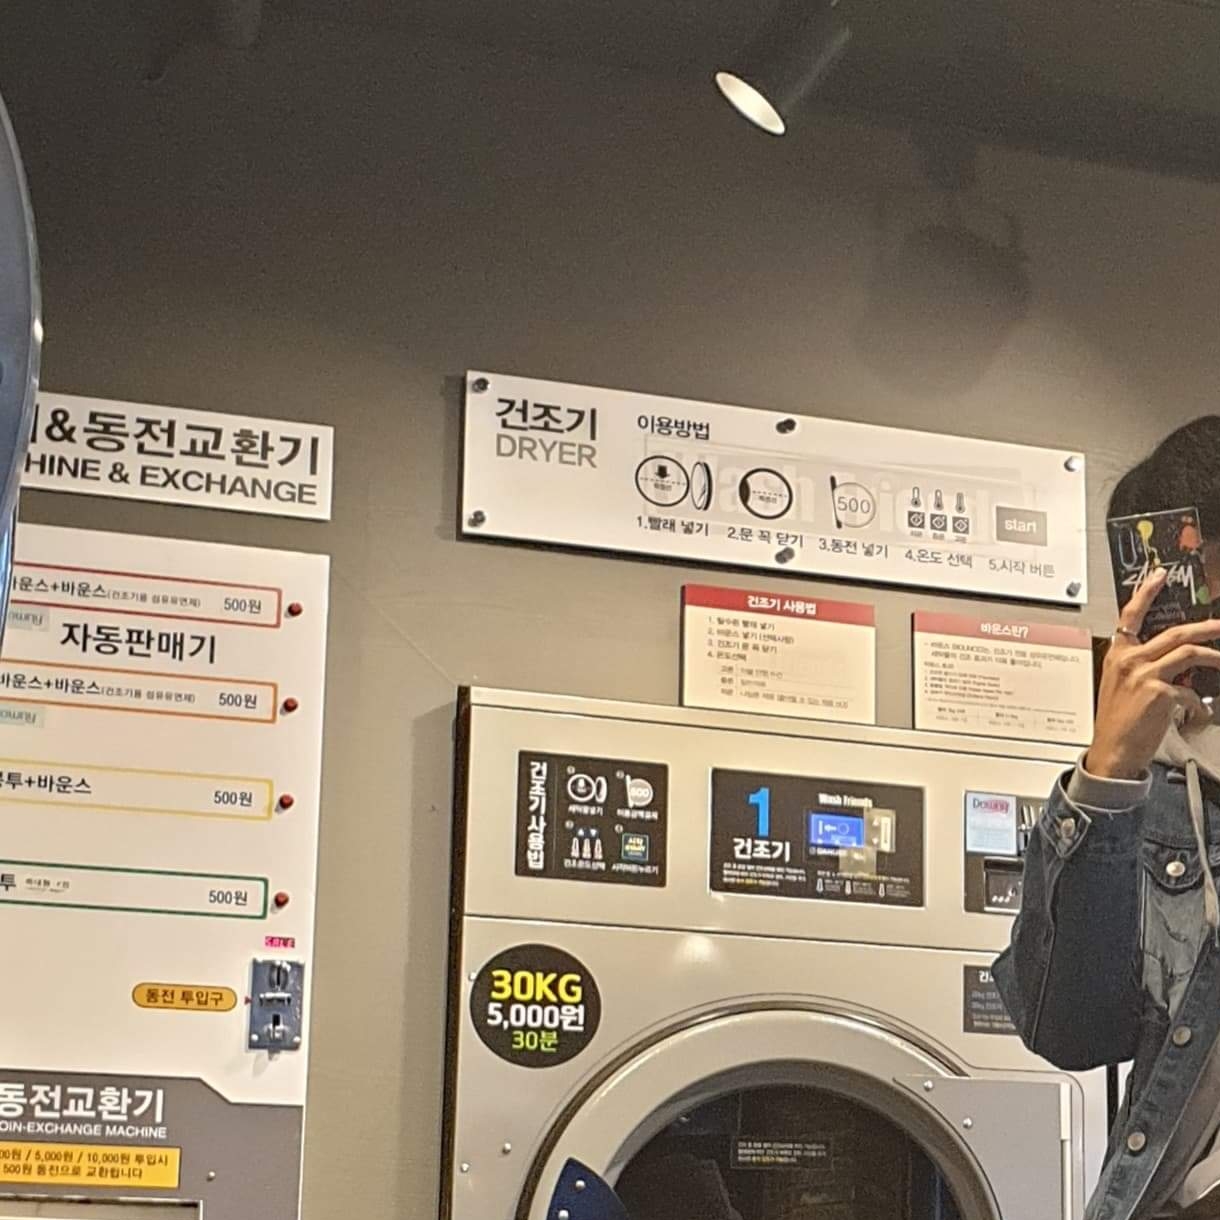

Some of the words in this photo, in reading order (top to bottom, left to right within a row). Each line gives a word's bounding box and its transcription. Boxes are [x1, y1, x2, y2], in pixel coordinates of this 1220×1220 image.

[495, 398, 597, 440] 건조기
[637, 414, 710, 440] 이용방법
[495, 434, 597, 468] DRYER
[108, 462, 130, 484] &
[140, 466, 318, 506] EXCHANGE
[837, 496, 871, 514] 500
[1005, 518, 1037, 533] start
[224, 597, 262, 614] 500원
[746, 595, 780, 611] 건조기
[783, 602, 817, 616] 사용법
[60, 622, 217, 664] 자동판매기
[218, 692, 258, 709] 500원
[214, 791, 253, 807] 500원
[748, 787, 770, 837] 1
[733, 838, 790, 862] 건조기
[208, 890, 248, 906] 500원
[146, 988, 175, 1005] 동전
[180, 990, 223, 1007] 투입구
[491, 969, 582, 1004] 30KG
[487, 1002, 585, 1032] 5,000원
[512, 1031, 558, 1052] 30분
[0, 1082, 164, 1124] 동전교환기
[105, 1125, 167, 1139] MACHINE
